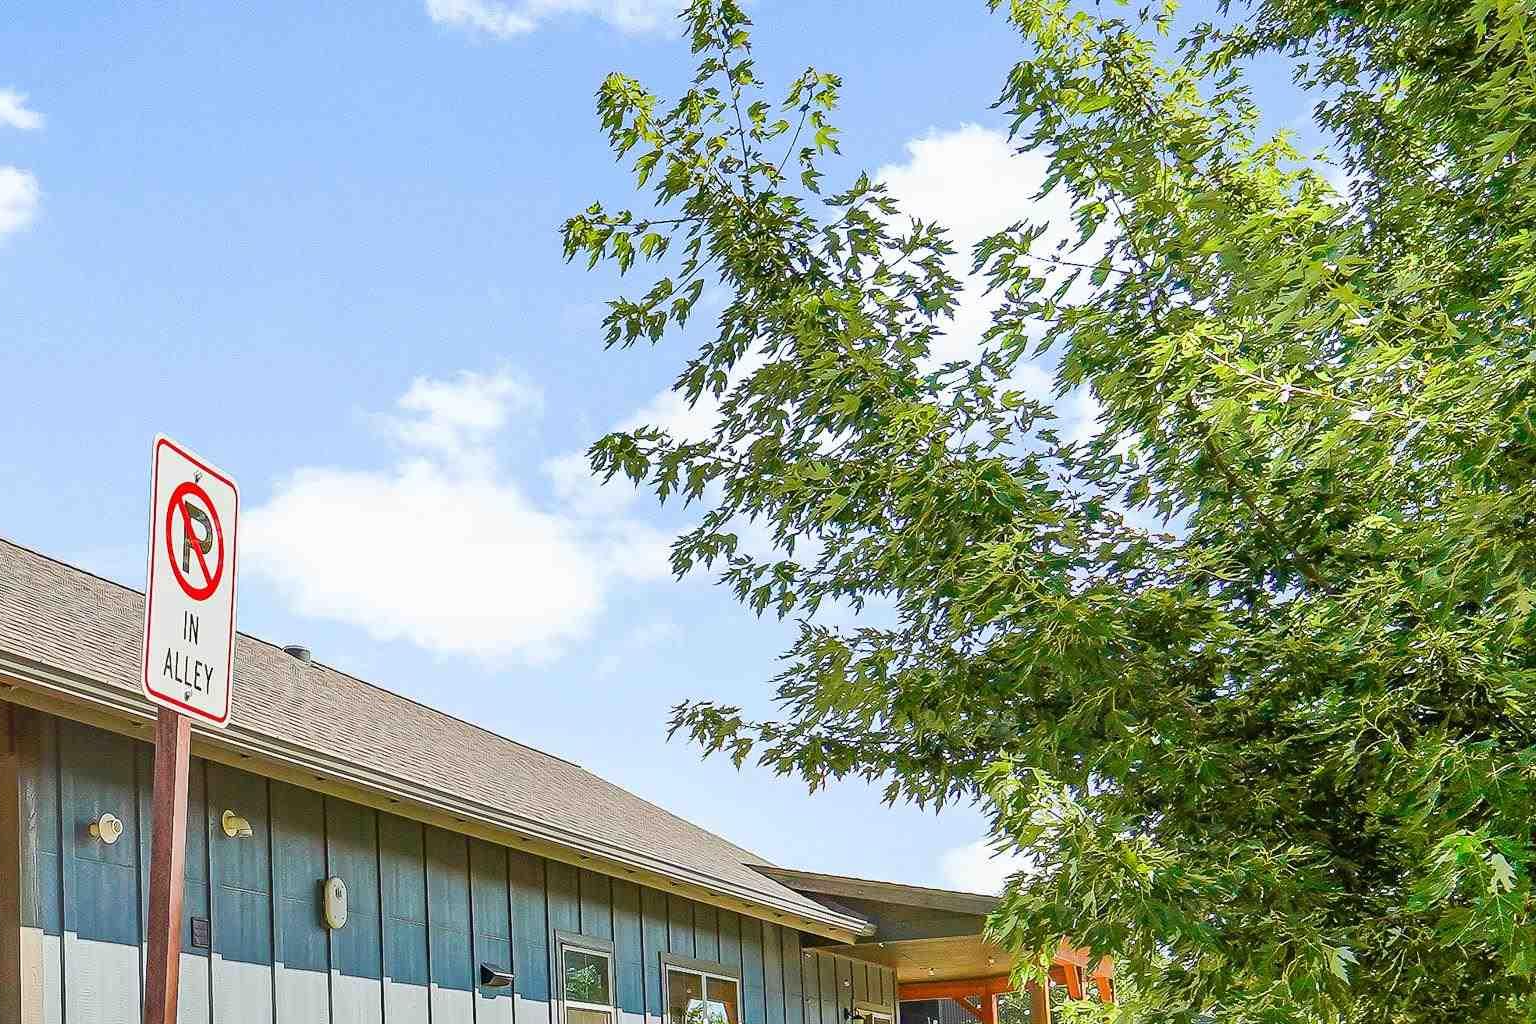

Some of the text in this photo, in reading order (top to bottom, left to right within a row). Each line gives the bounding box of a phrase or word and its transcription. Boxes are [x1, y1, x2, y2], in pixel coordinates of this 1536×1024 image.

[182, 500, 213, 574] P
[183, 610, 199, 646] IN
[163, 647, 214, 695] ALLEY
